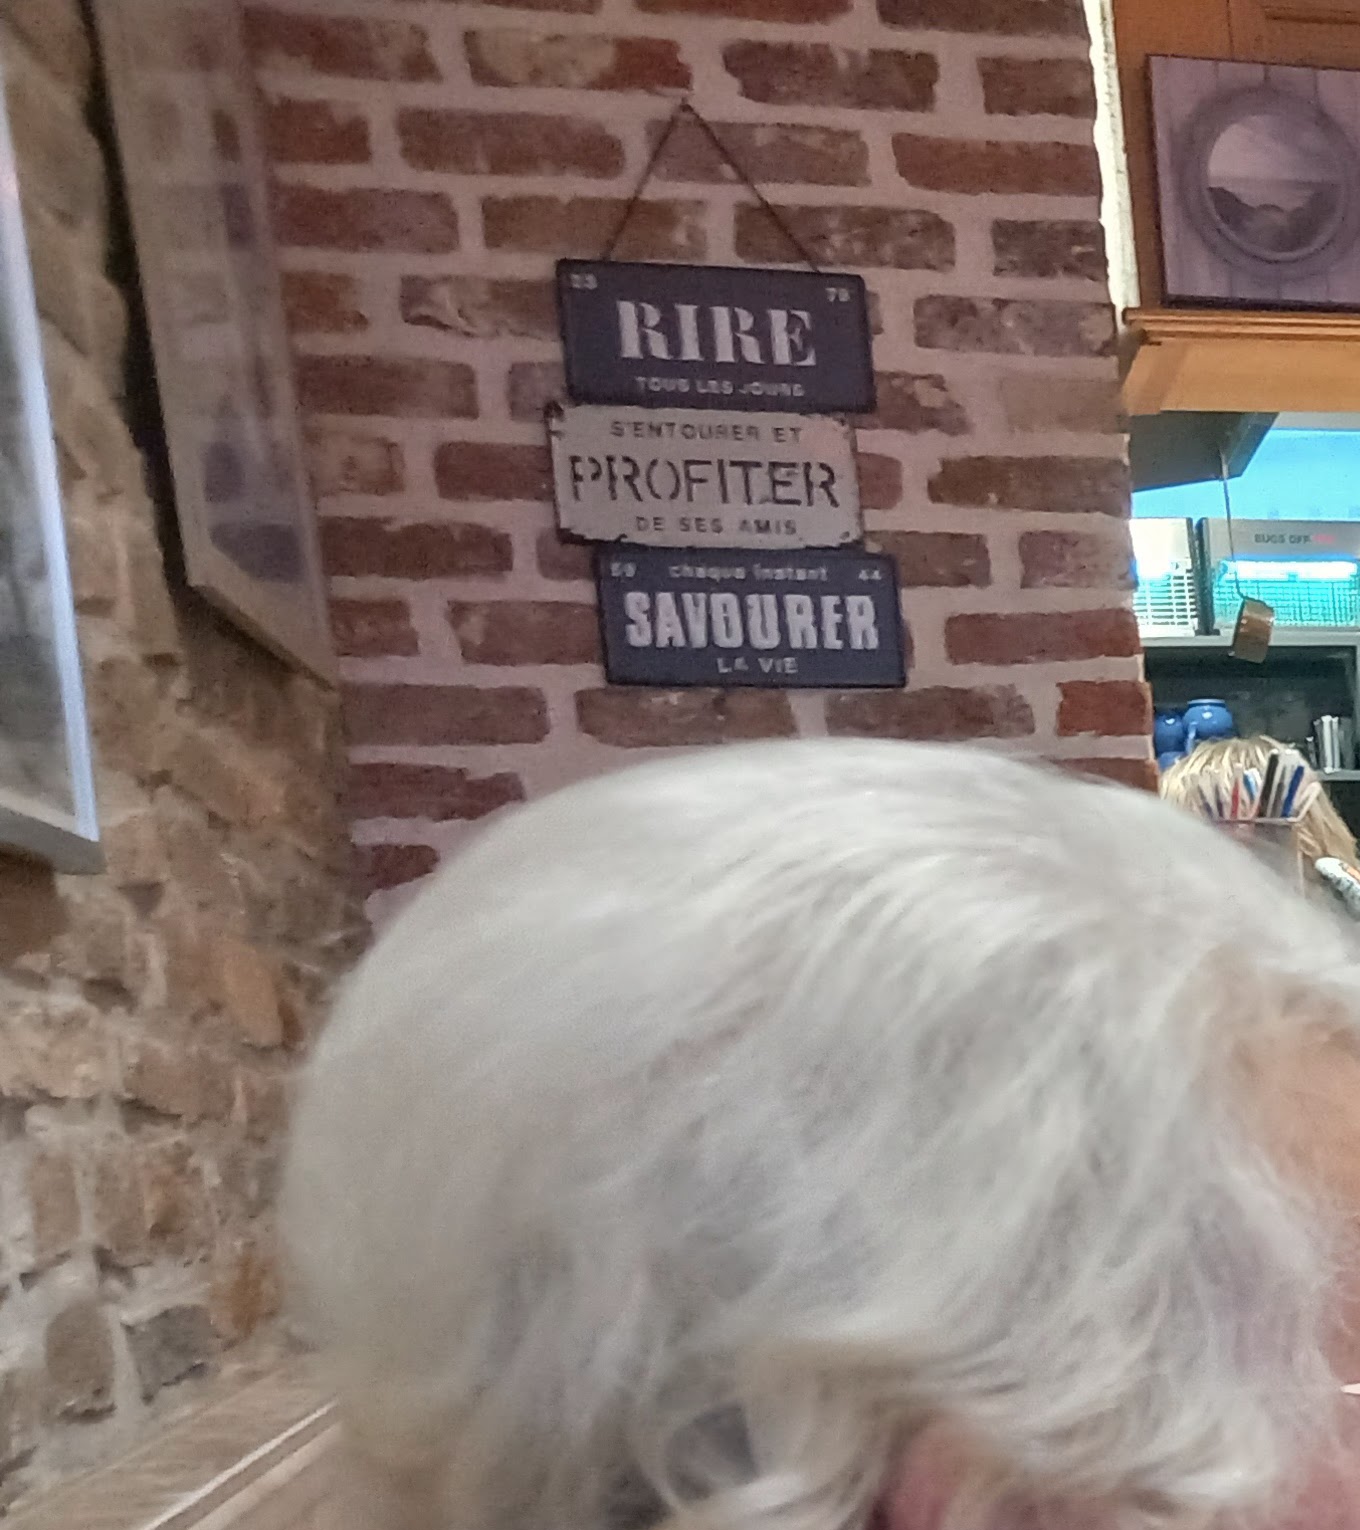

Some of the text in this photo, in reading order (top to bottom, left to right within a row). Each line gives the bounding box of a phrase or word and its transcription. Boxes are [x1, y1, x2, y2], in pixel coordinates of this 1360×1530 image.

[616, 300, 817, 366] RIRE
[636, 376, 690, 392] TOUS
[696, 380, 734, 394] LES
[609, 421, 803, 442] S'ENTOURER ET
[569, 454, 841, 508] PROFITER
[635, 516, 798, 535] DE SES AMIS
[625, 591, 879, 650] SAVOURER
[717, 657, 798, 674] LA VIE
